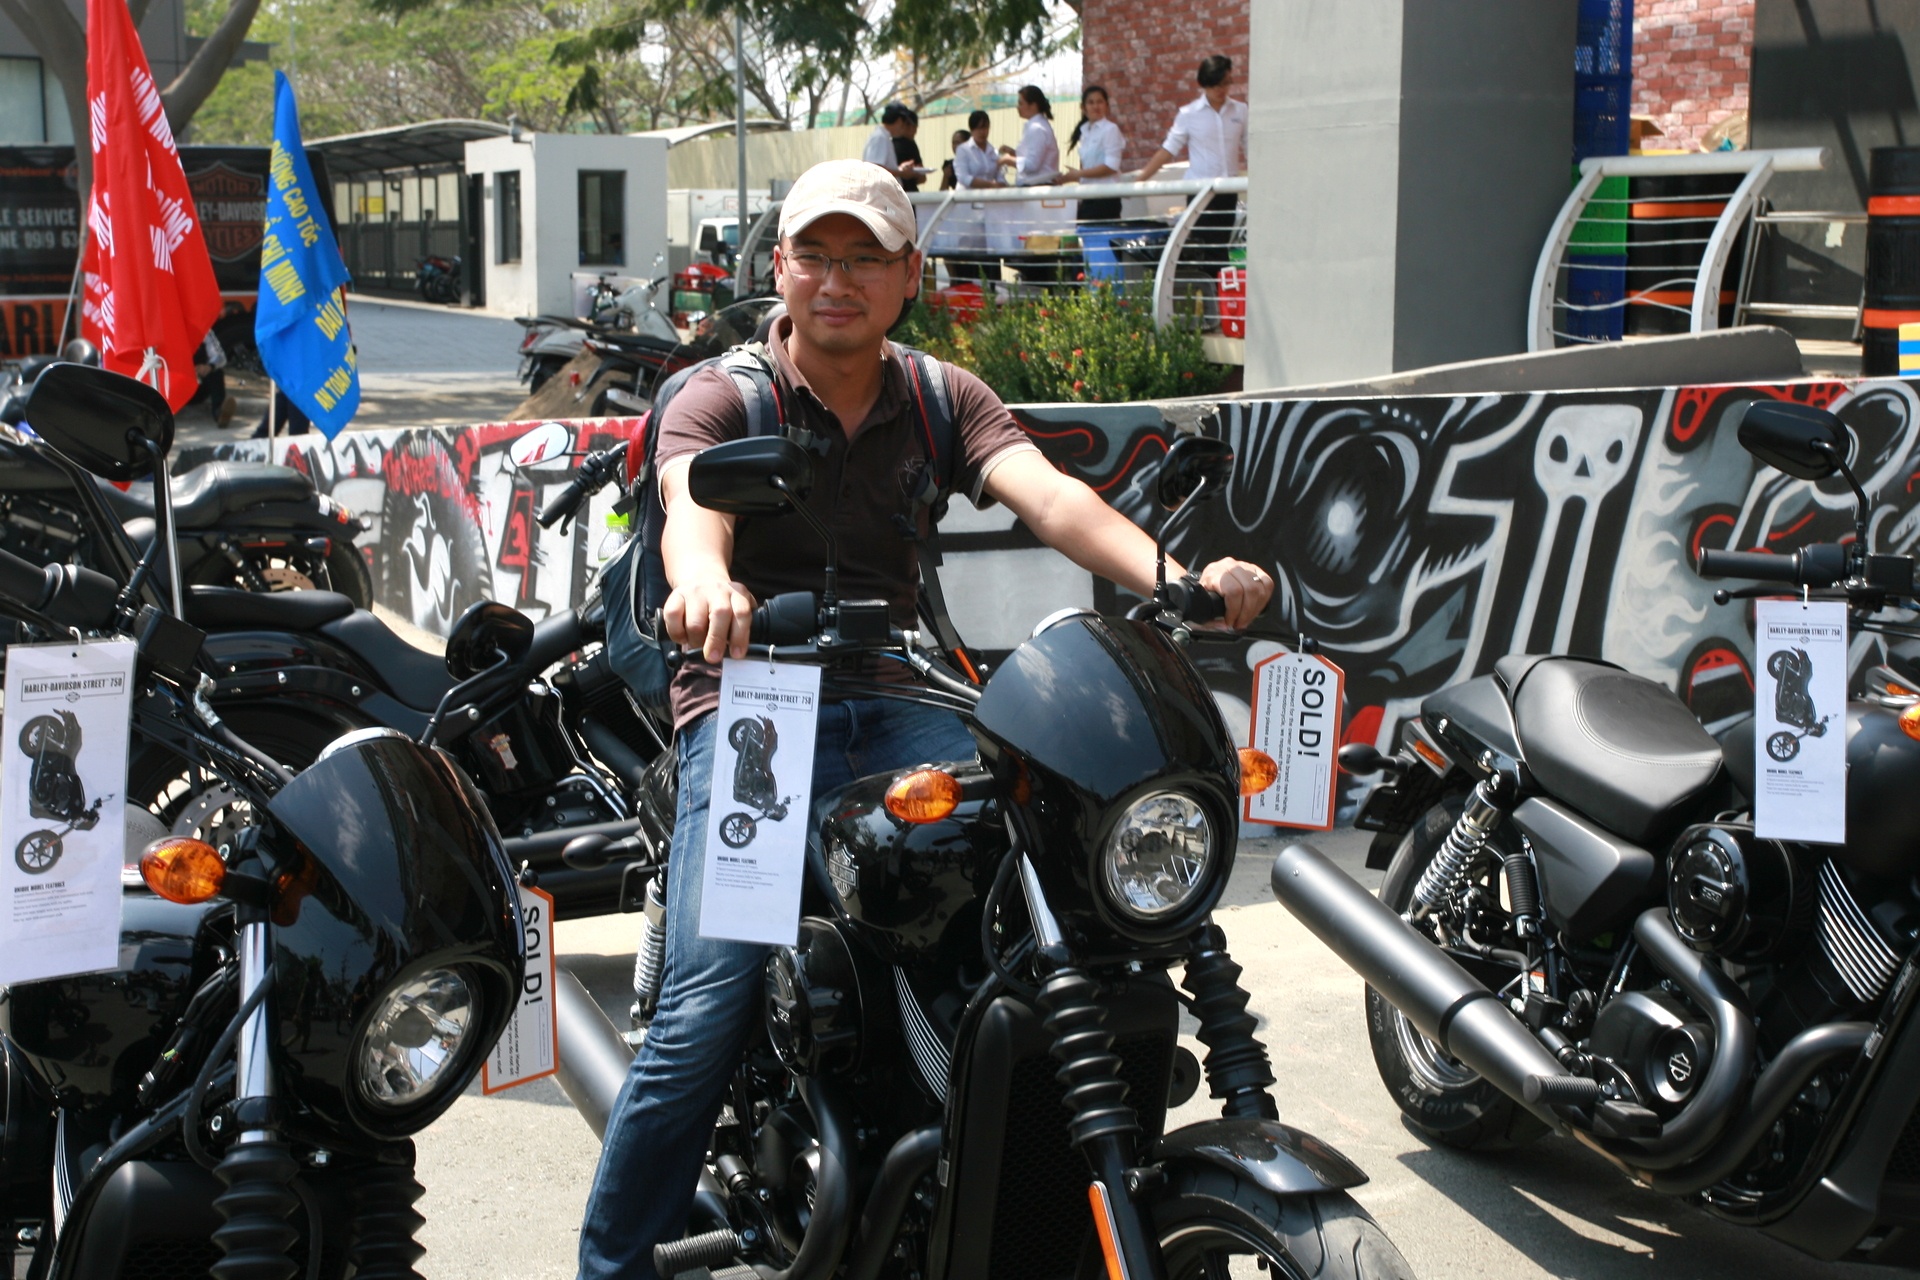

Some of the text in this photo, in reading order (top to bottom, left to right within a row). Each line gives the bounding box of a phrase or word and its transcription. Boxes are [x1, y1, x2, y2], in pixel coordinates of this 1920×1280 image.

[17, 207, 77, 227] SERVICE
[282, 187, 308, 218] CAO
[296, 214, 322, 248] TỐC
[313, 386, 337, 413] AN
[1769, 626, 1810, 635] HARLEY-DAVIDSON
[23, 680, 81, 693] HARLEY-DAVIDSON
[110, 677, 122, 686] 750
[734, 690, 778, 701] HARLEY-DAVIDSON
[801, 696, 811, 704] 750
[1288, 685, 1296, 706] respect
[1279, 694, 1287, 726] motorcycle,
[1297, 668, 1325, 757] SOLD!
[1280, 728, 1284, 736] we
